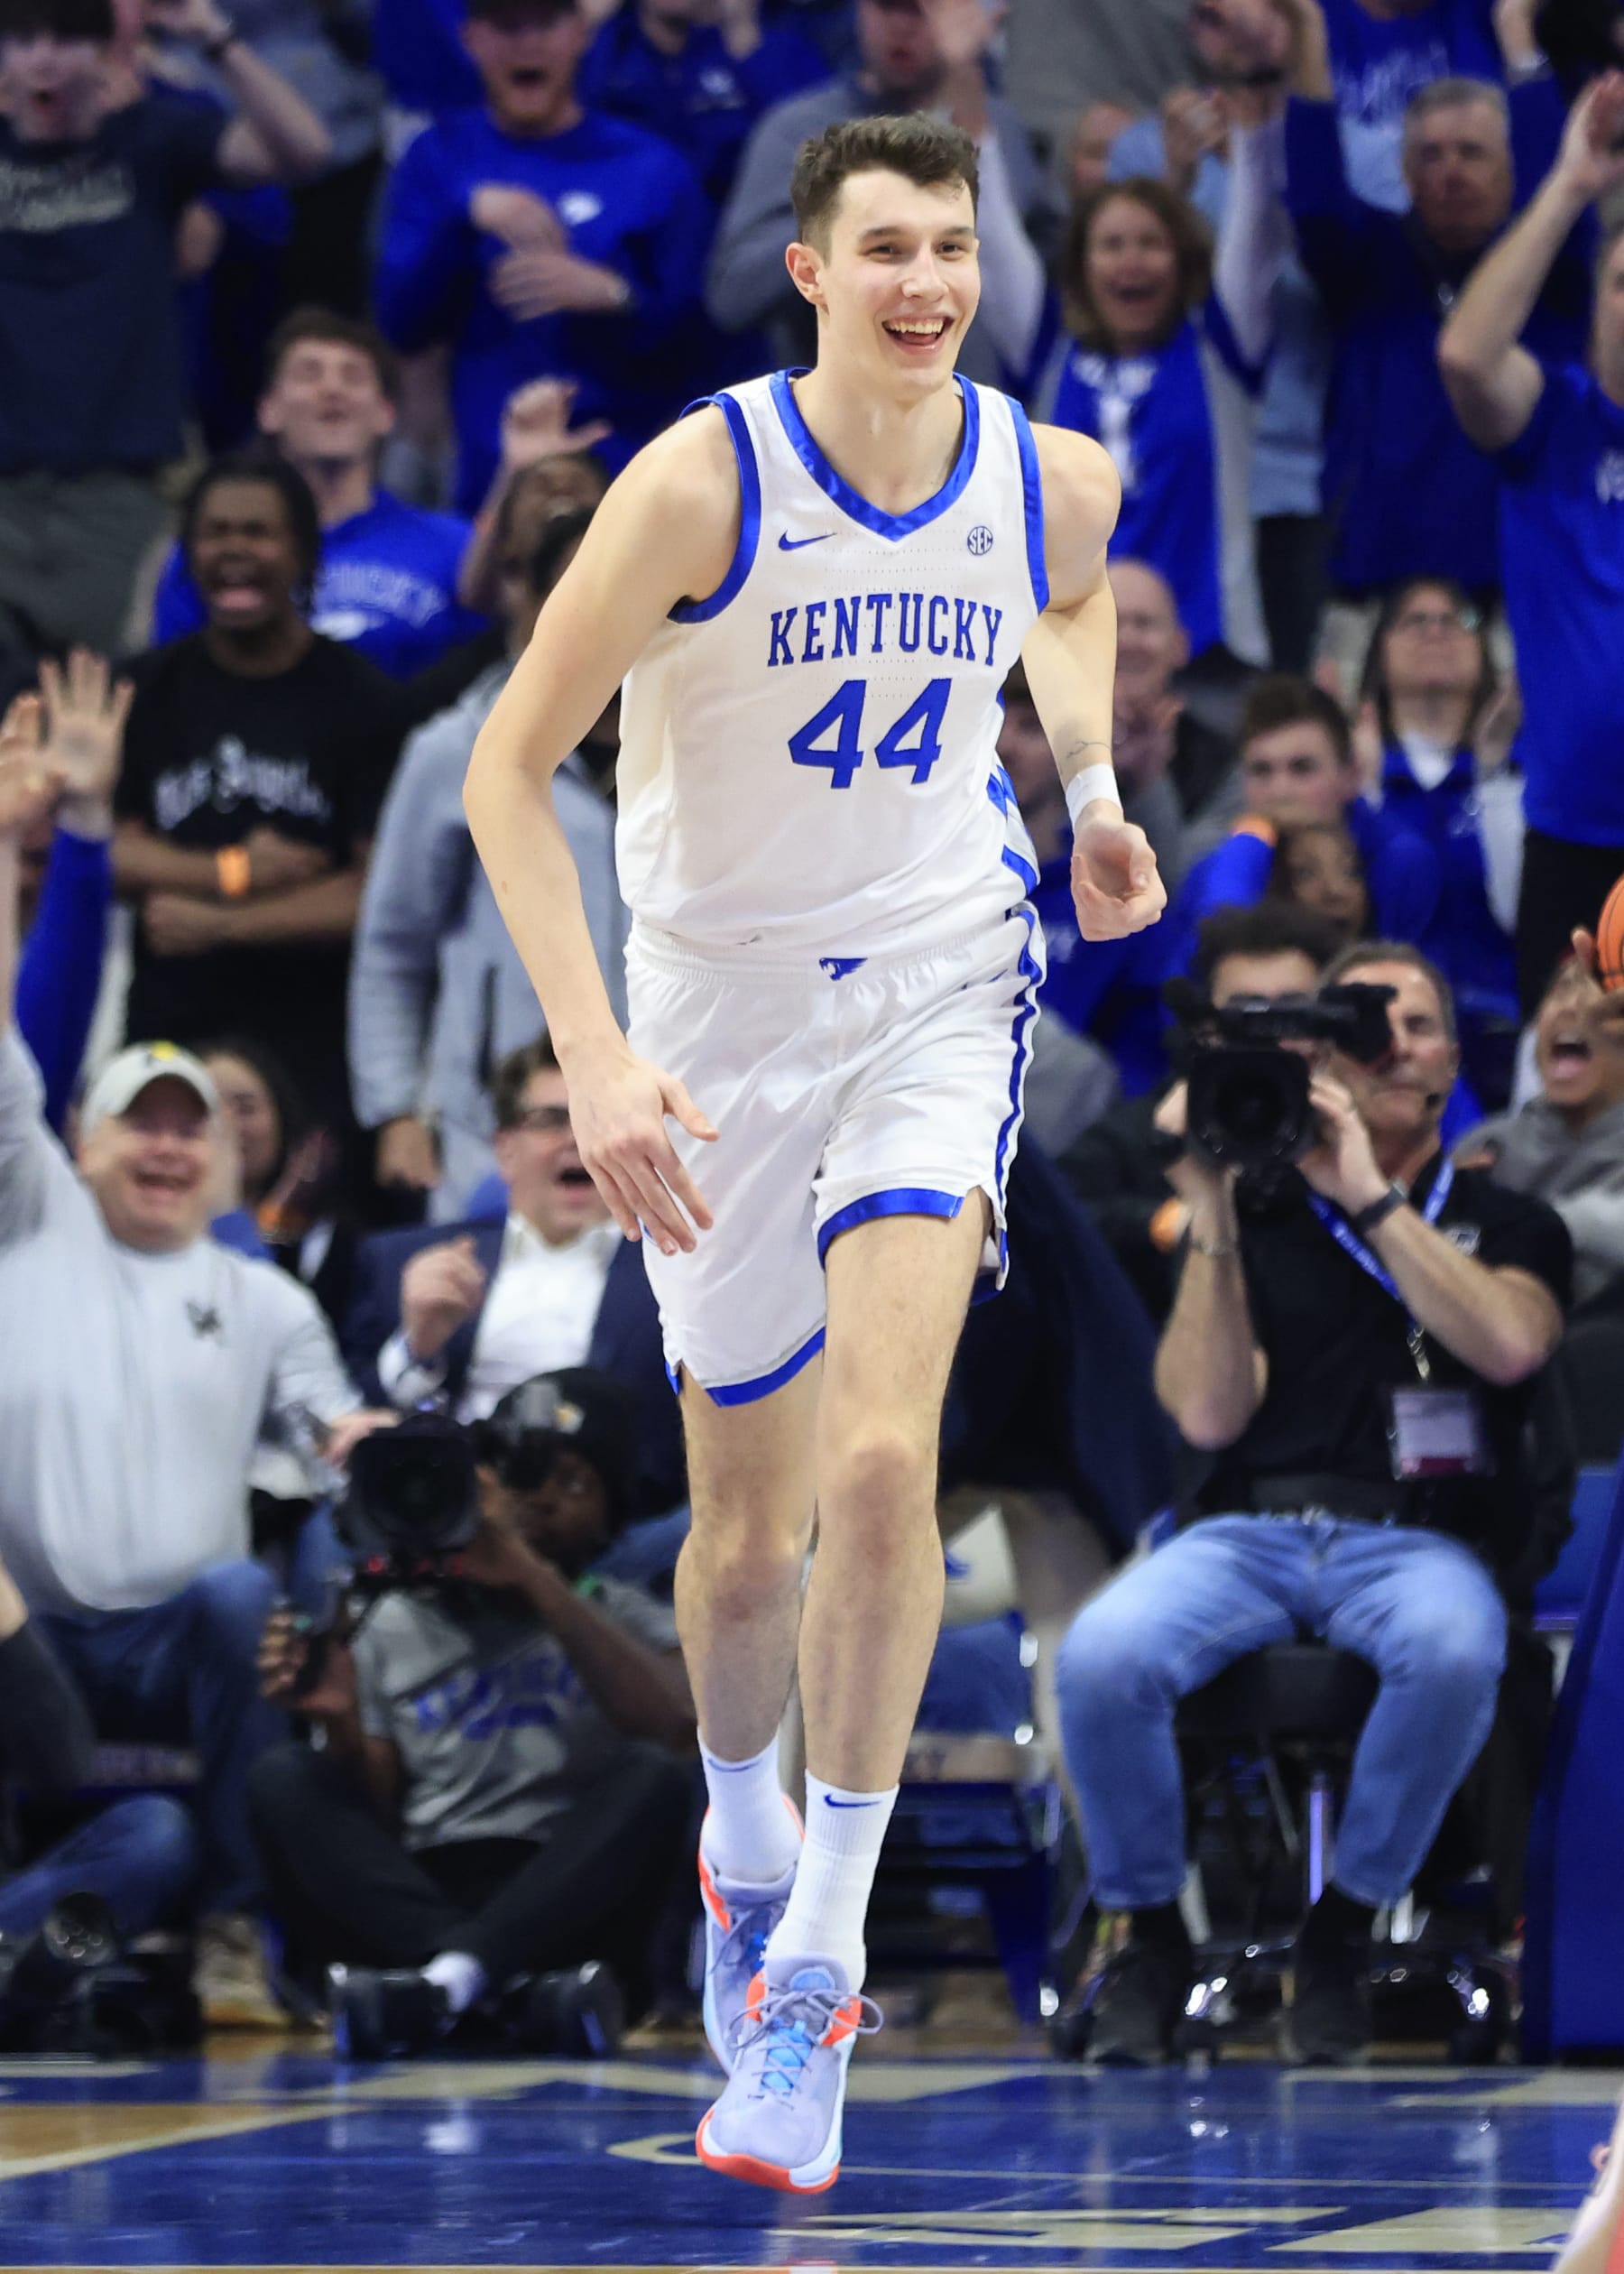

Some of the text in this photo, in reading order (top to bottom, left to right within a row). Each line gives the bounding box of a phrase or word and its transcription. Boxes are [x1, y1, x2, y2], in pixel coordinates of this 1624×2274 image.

[967, 526, 993, 556] SEC
[767, 593, 1002, 667] KENTUCKY
[788, 678, 952, 789] 44
